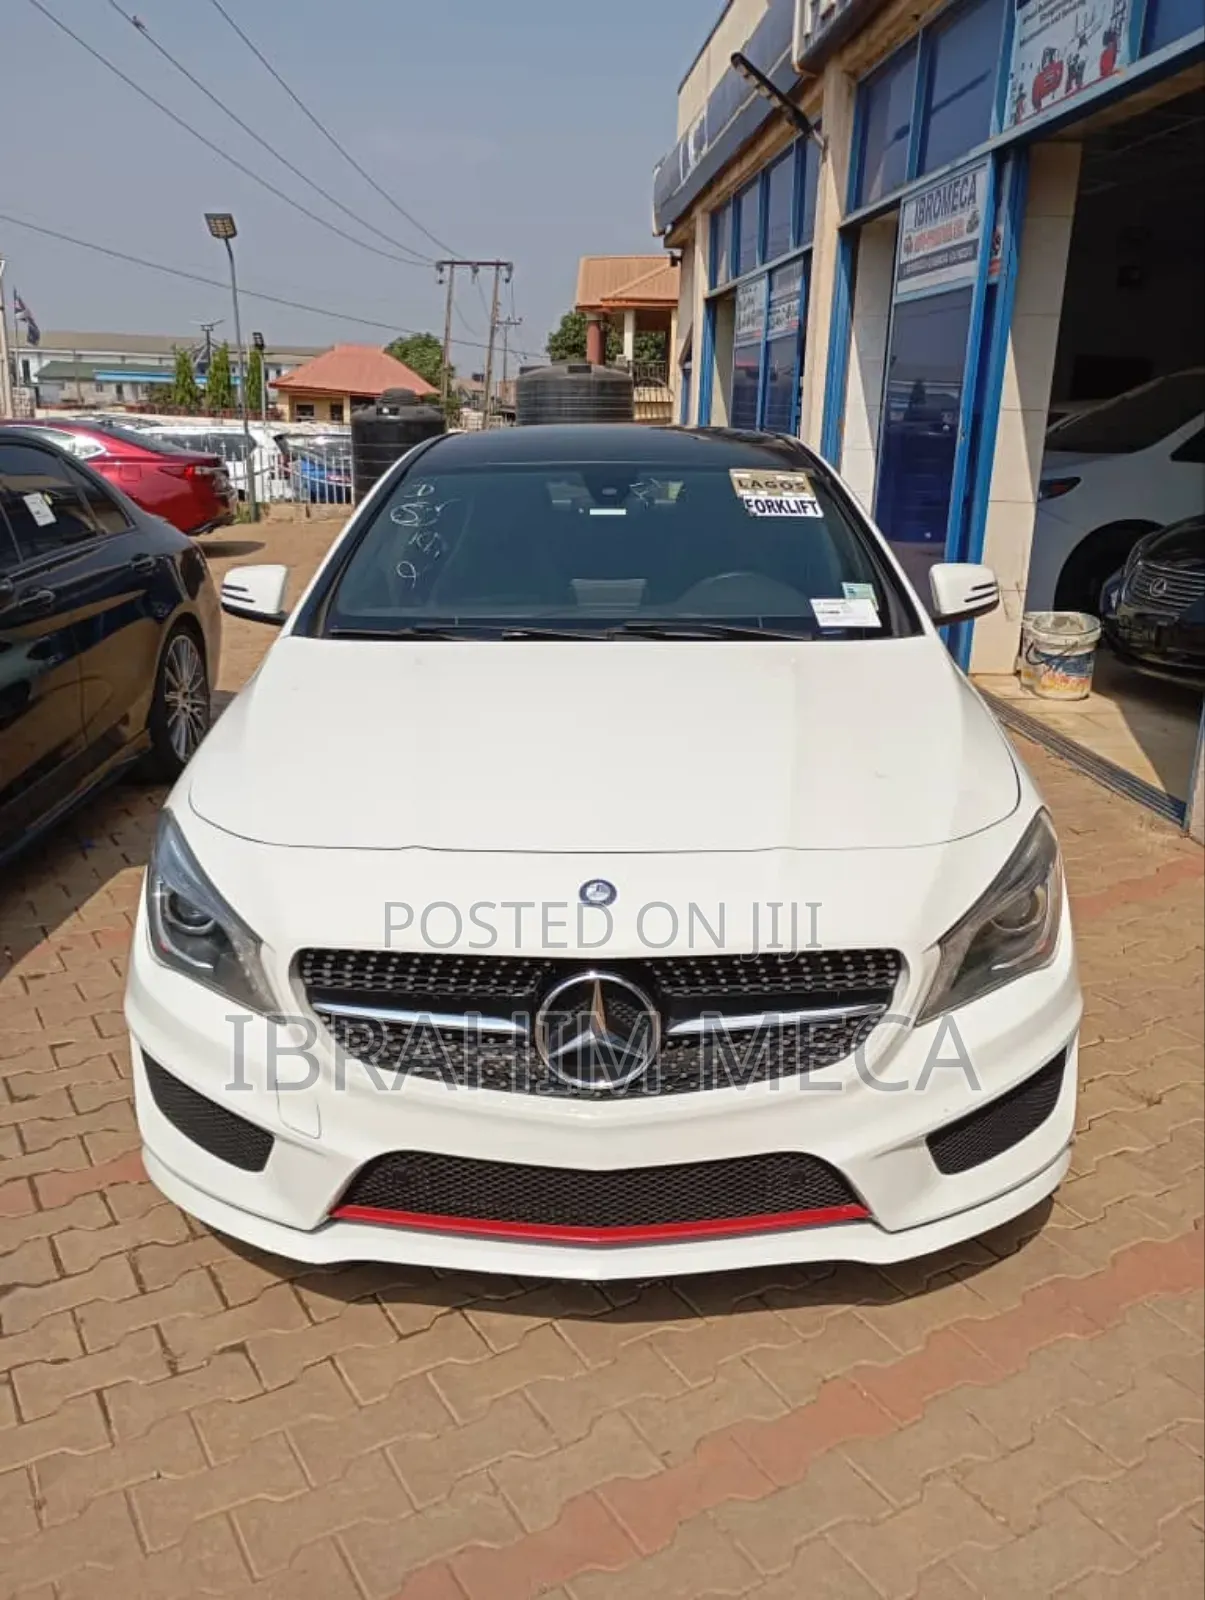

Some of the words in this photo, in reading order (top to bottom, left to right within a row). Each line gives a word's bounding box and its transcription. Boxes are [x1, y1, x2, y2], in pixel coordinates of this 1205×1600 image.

[914, 172, 977, 228] IBROMECA
[737, 479, 806, 491] LAGOS
[744, 499, 819, 515] FORKLIFT
